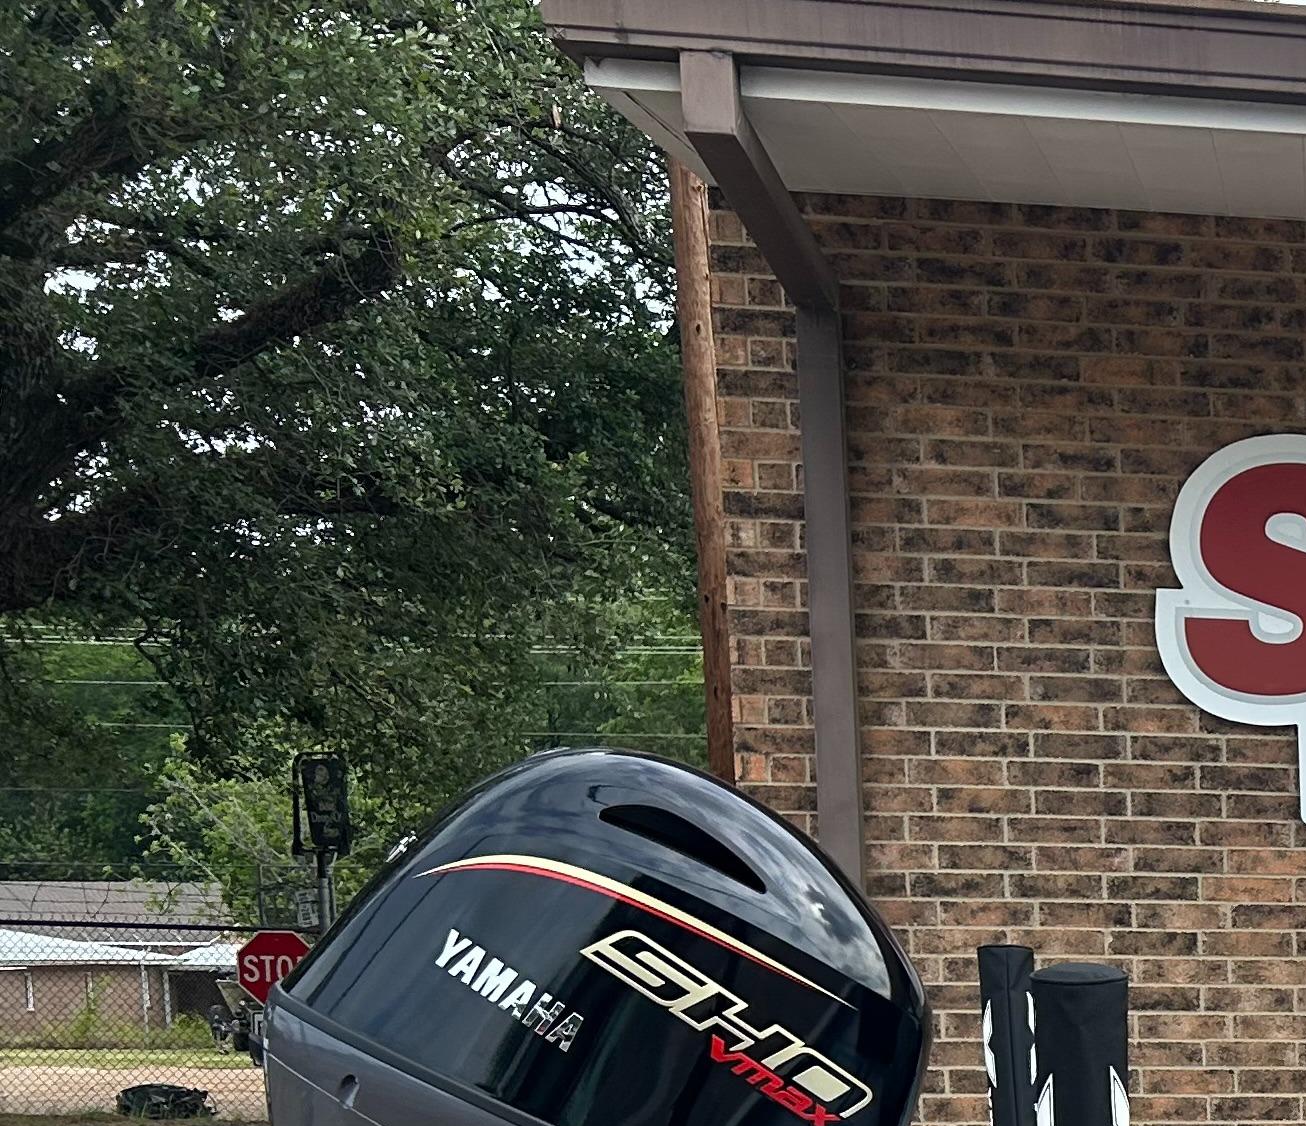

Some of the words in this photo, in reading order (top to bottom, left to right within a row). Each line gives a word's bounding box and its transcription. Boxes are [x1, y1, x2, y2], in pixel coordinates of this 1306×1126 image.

[243, 954, 303, 984] STO
[433, 928, 585, 1053] YAMAHA
[580, 929, 874, 1119] SHO
